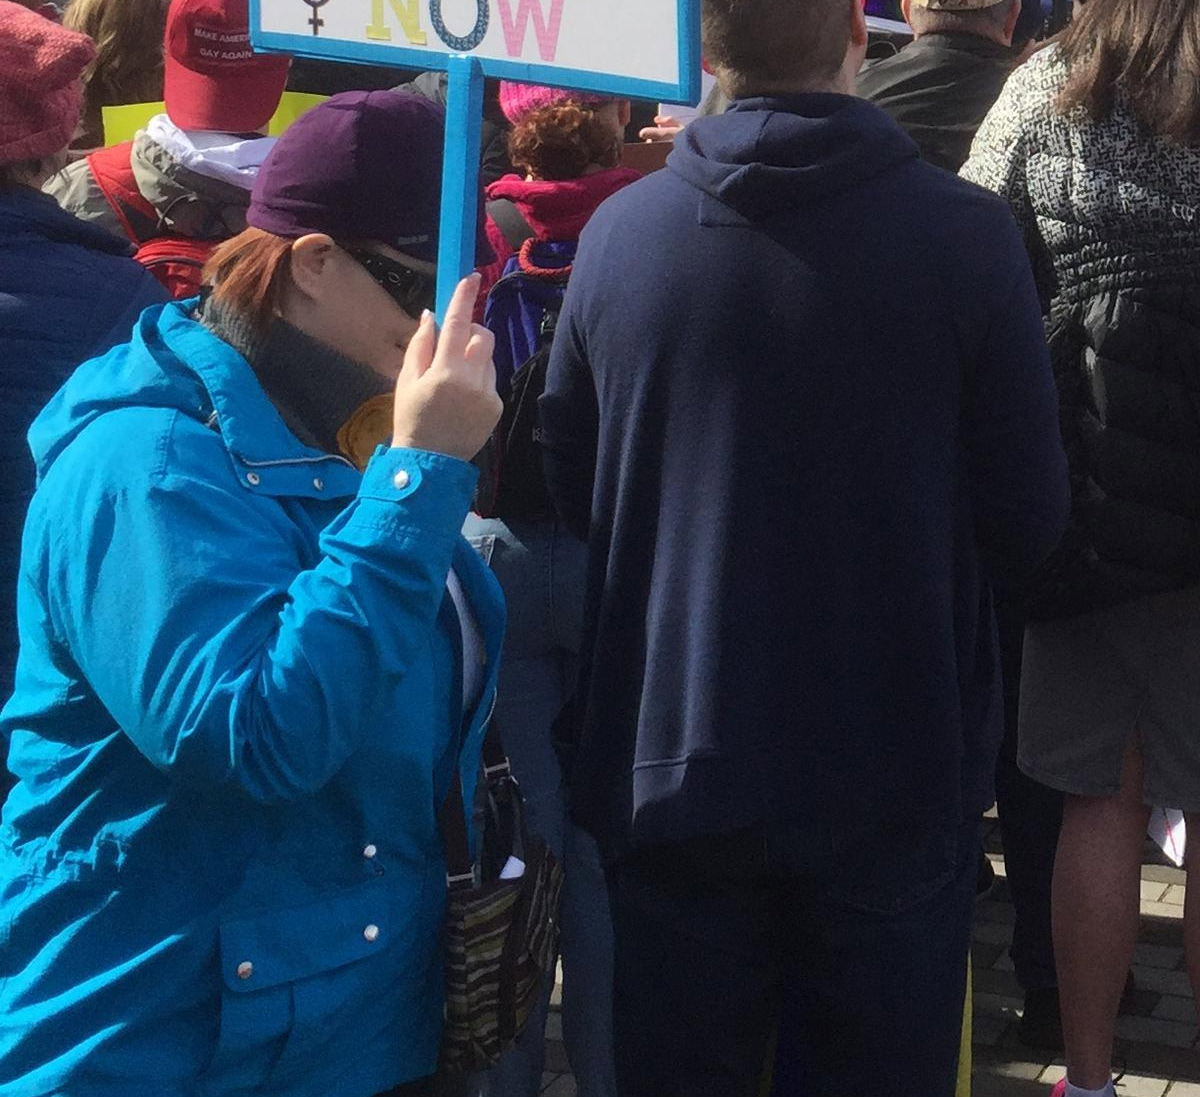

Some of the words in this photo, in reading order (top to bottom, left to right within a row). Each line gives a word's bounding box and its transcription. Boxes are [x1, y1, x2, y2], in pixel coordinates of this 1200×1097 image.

[194, 28, 217, 41] MAKE
[219, 33, 251, 44] AMERI
[200, 47, 219, 58] GAY
[221, 50, 252, 60] AGAIN
